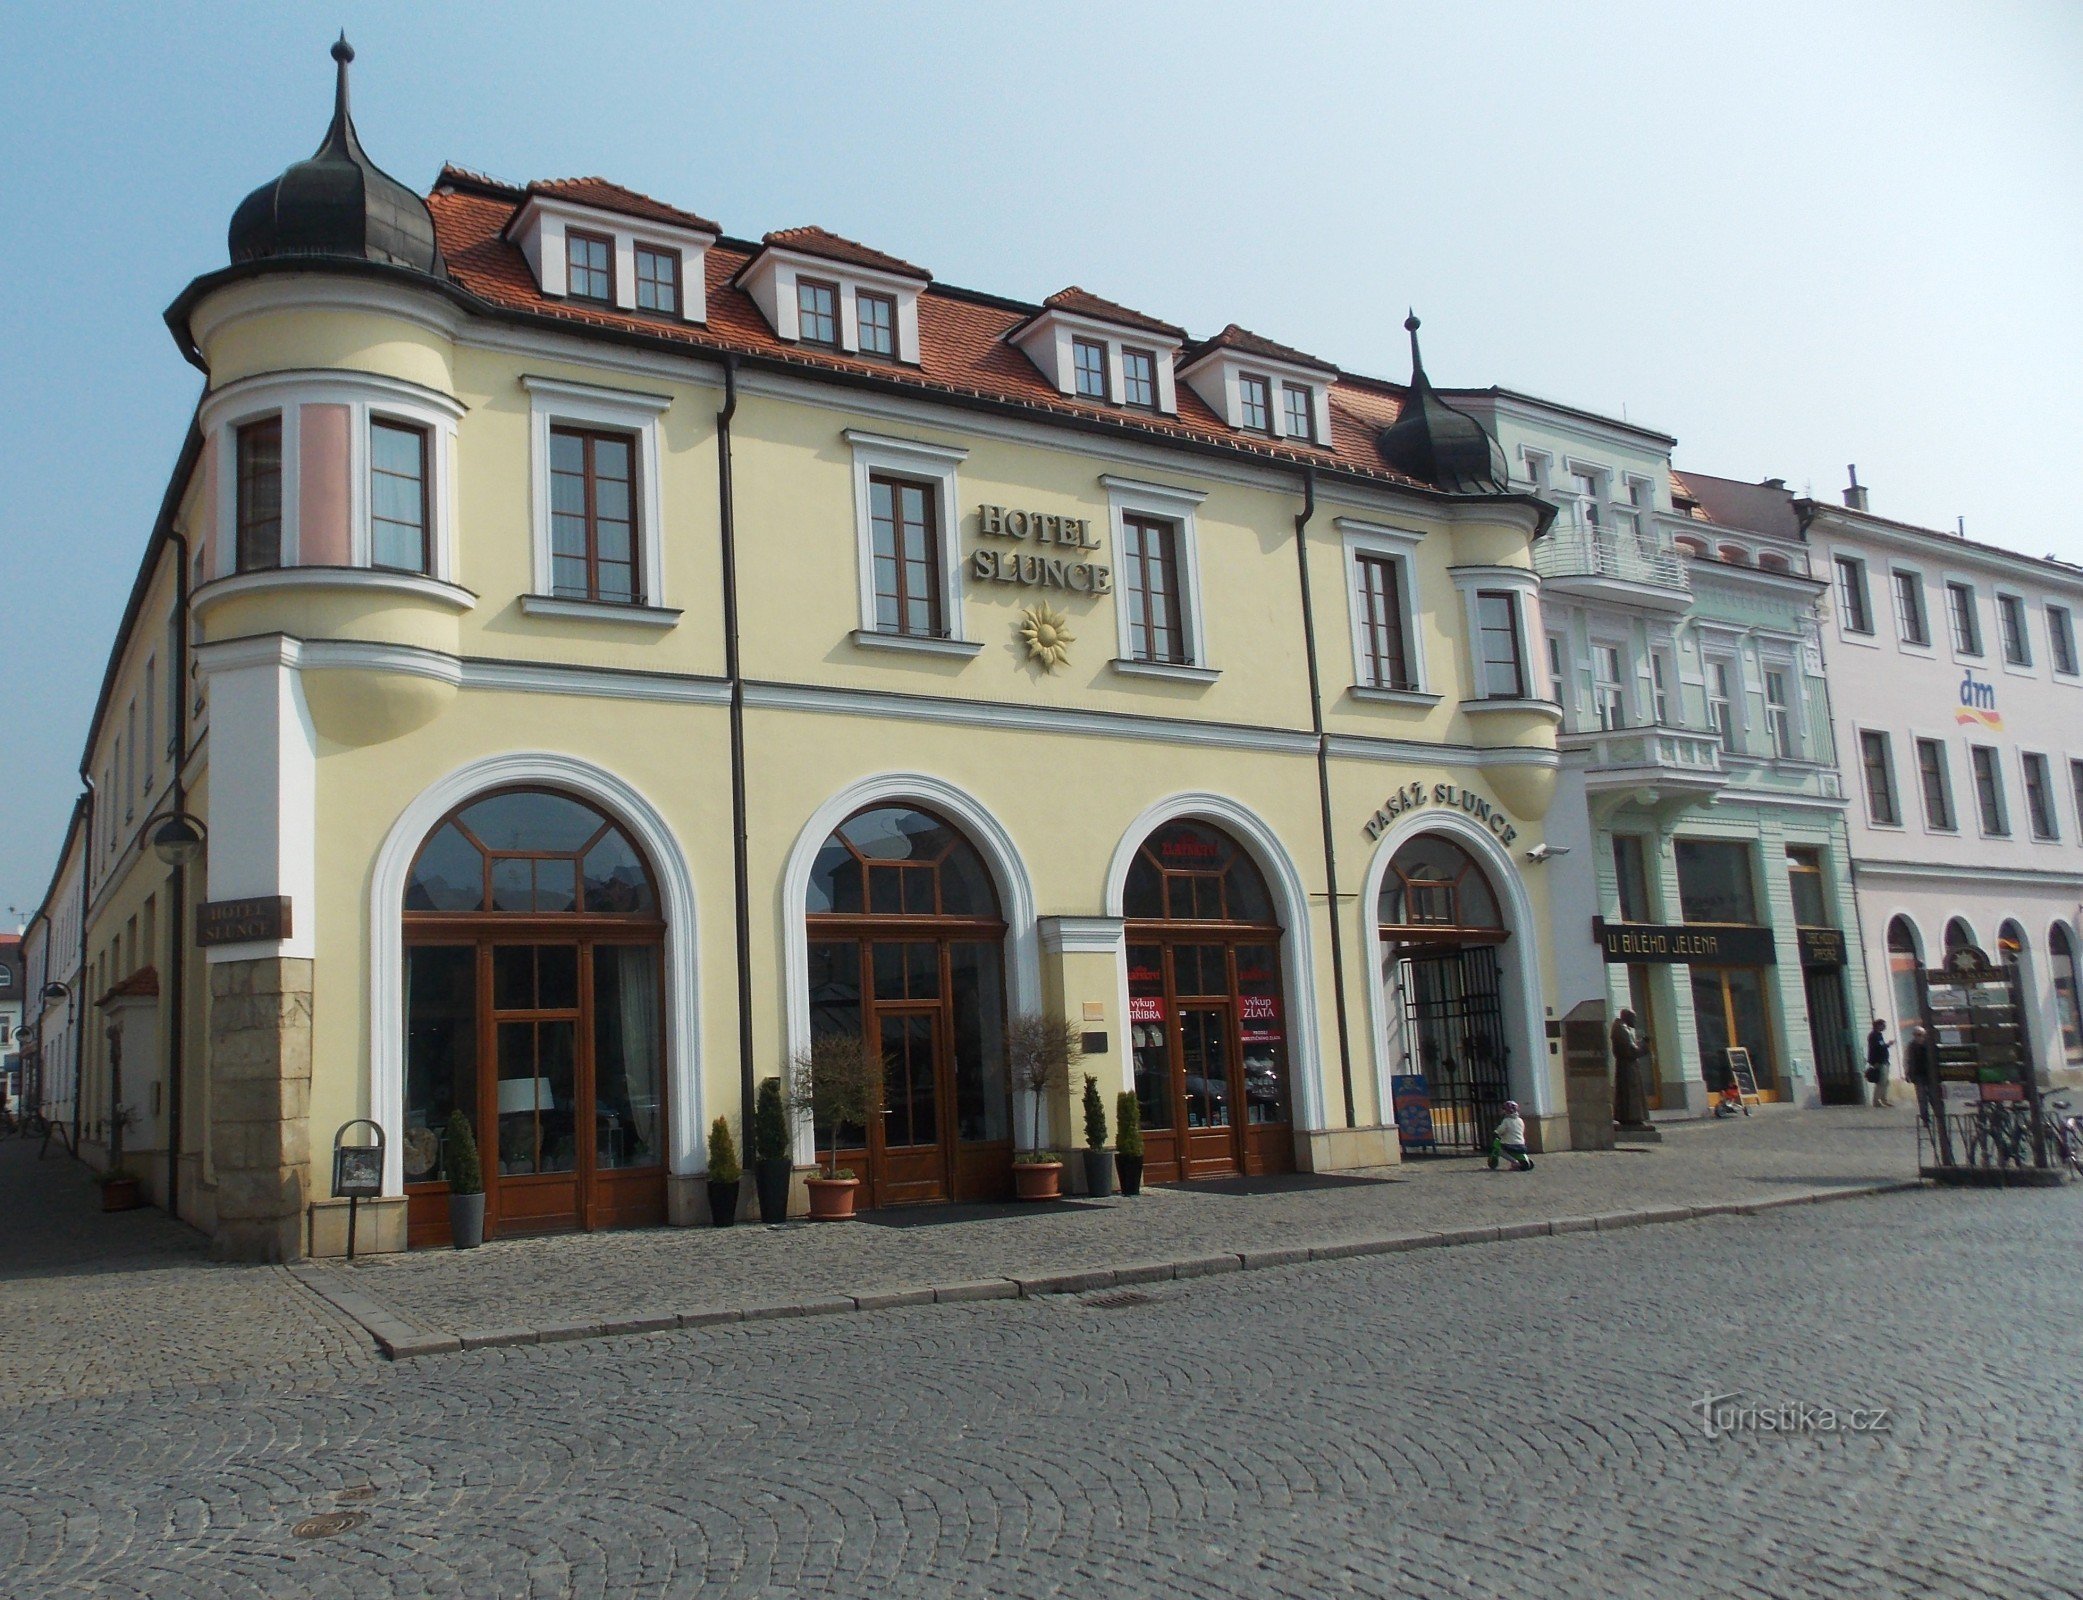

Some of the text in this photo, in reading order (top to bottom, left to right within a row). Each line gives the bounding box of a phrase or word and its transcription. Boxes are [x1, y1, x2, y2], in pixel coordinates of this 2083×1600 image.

[978, 504, 1101, 550] HOTEL
[970, 548, 1112, 595] SLUNCE
[1960, 669, 1995, 710] dm
[1362, 781, 1518, 847] PASÁŽ SLUNCE
[210, 903, 265, 921] HOTEL
[204, 921, 271, 940] SLUNCE
[1607, 930, 1719, 955] U BÍLÉHO JELENA
[1130, 997, 1156, 1010] výkup
[1243, 1008, 1275, 1018] ZLATA
[1244, 996, 1272, 1010] výkup
